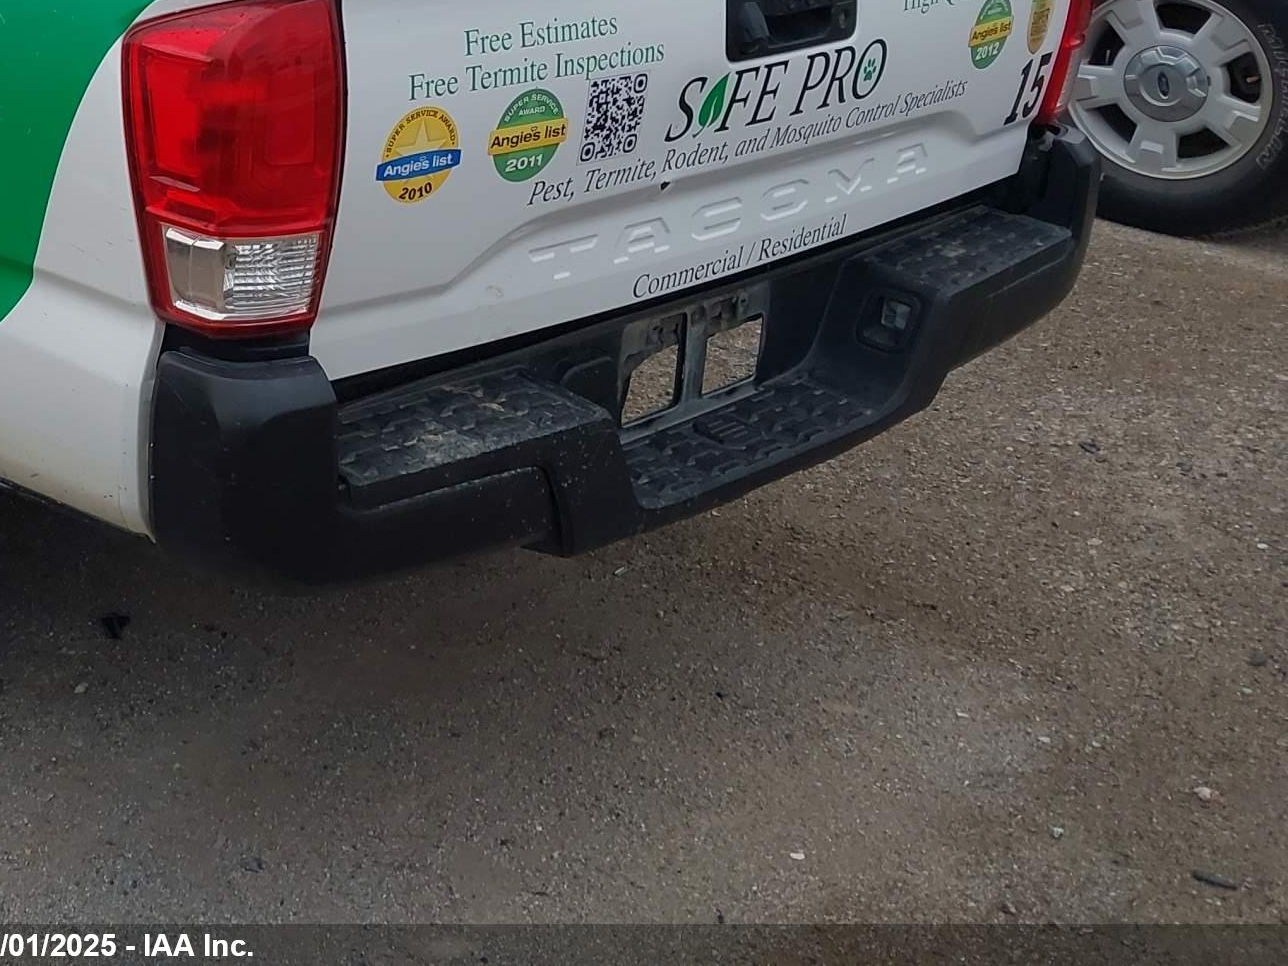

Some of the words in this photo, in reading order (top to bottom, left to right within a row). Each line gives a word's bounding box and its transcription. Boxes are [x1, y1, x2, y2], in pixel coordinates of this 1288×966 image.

[463, 28, 513, 56] Free
[519, 15, 619, 49] Estimates
[408, 73, 460, 102] Free
[465, 57, 549, 92] Termite
[554, 40, 665, 82] Inspections
[789, 38, 888, 117] PRO
[1002, 52, 1052, 127] 15
[504, 97, 529, 123] SUPER
[530, 93, 560, 115] SERVICE
[517, 105, 546, 117] AWARD
[386, 123, 406, 153] SUPER
[406, 109, 439, 125] SERVICE
[438, 113, 458, 142] AWARD
[526, 176, 576, 206] Pest,
[584, 157, 658, 193] Termite,
[661, 141, 730, 173] Rodent,
[734, 128, 772, 157] and
[768, 113, 842, 149] Mosquito
[845, 95, 901, 129] Control
[899, 79, 969, 118] Specialists
[544, 123, 567, 140] list
[432, 153, 454, 168] list
[504, 153, 544, 173] 2011
[398, 181, 433, 201] 2010
[632, 245, 745, 299] Commercial
[745, 241, 758, 267] /
[758, 213, 848, 262] Residential
